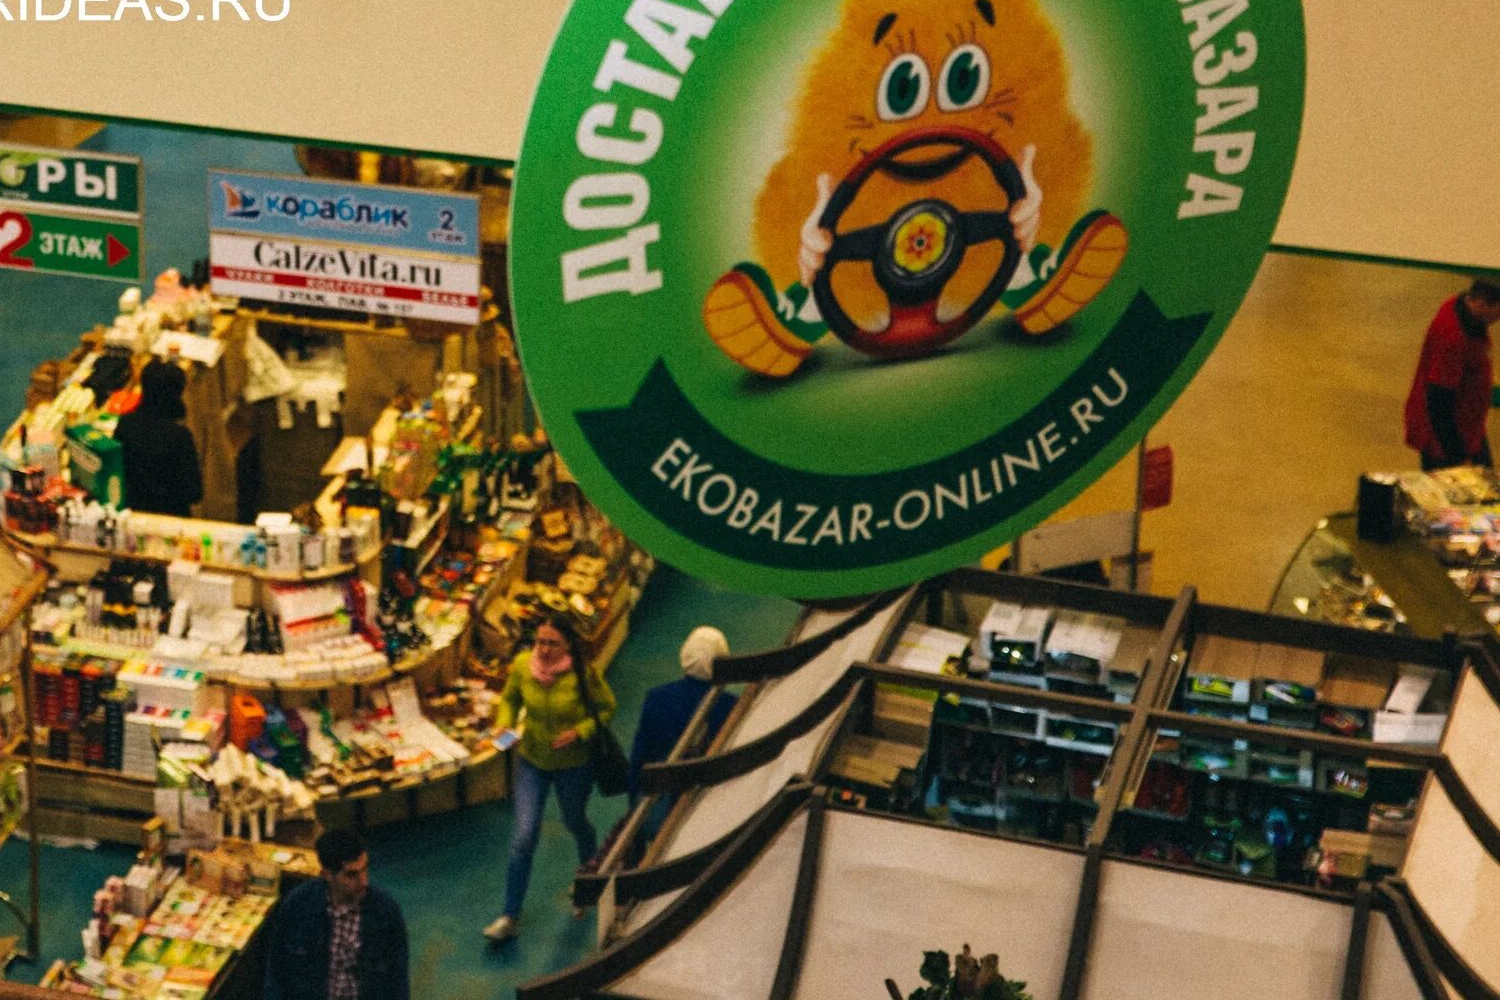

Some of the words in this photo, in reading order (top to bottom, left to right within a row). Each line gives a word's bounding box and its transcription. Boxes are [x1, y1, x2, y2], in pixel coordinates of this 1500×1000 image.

[266, 193, 409, 229] кораблик
[440, 209, 454, 231] 2
[39, 231, 104, 261] ЭТАЖ
[253, 240, 442, 287] CalzeVita.ru
[224, 268, 275, 284] ЧУЛКИ
[305, 278, 386, 297] КОЛГОТКИ
[652, 367, 1130, 547] EKOBAZAR-ONLINE.RU
